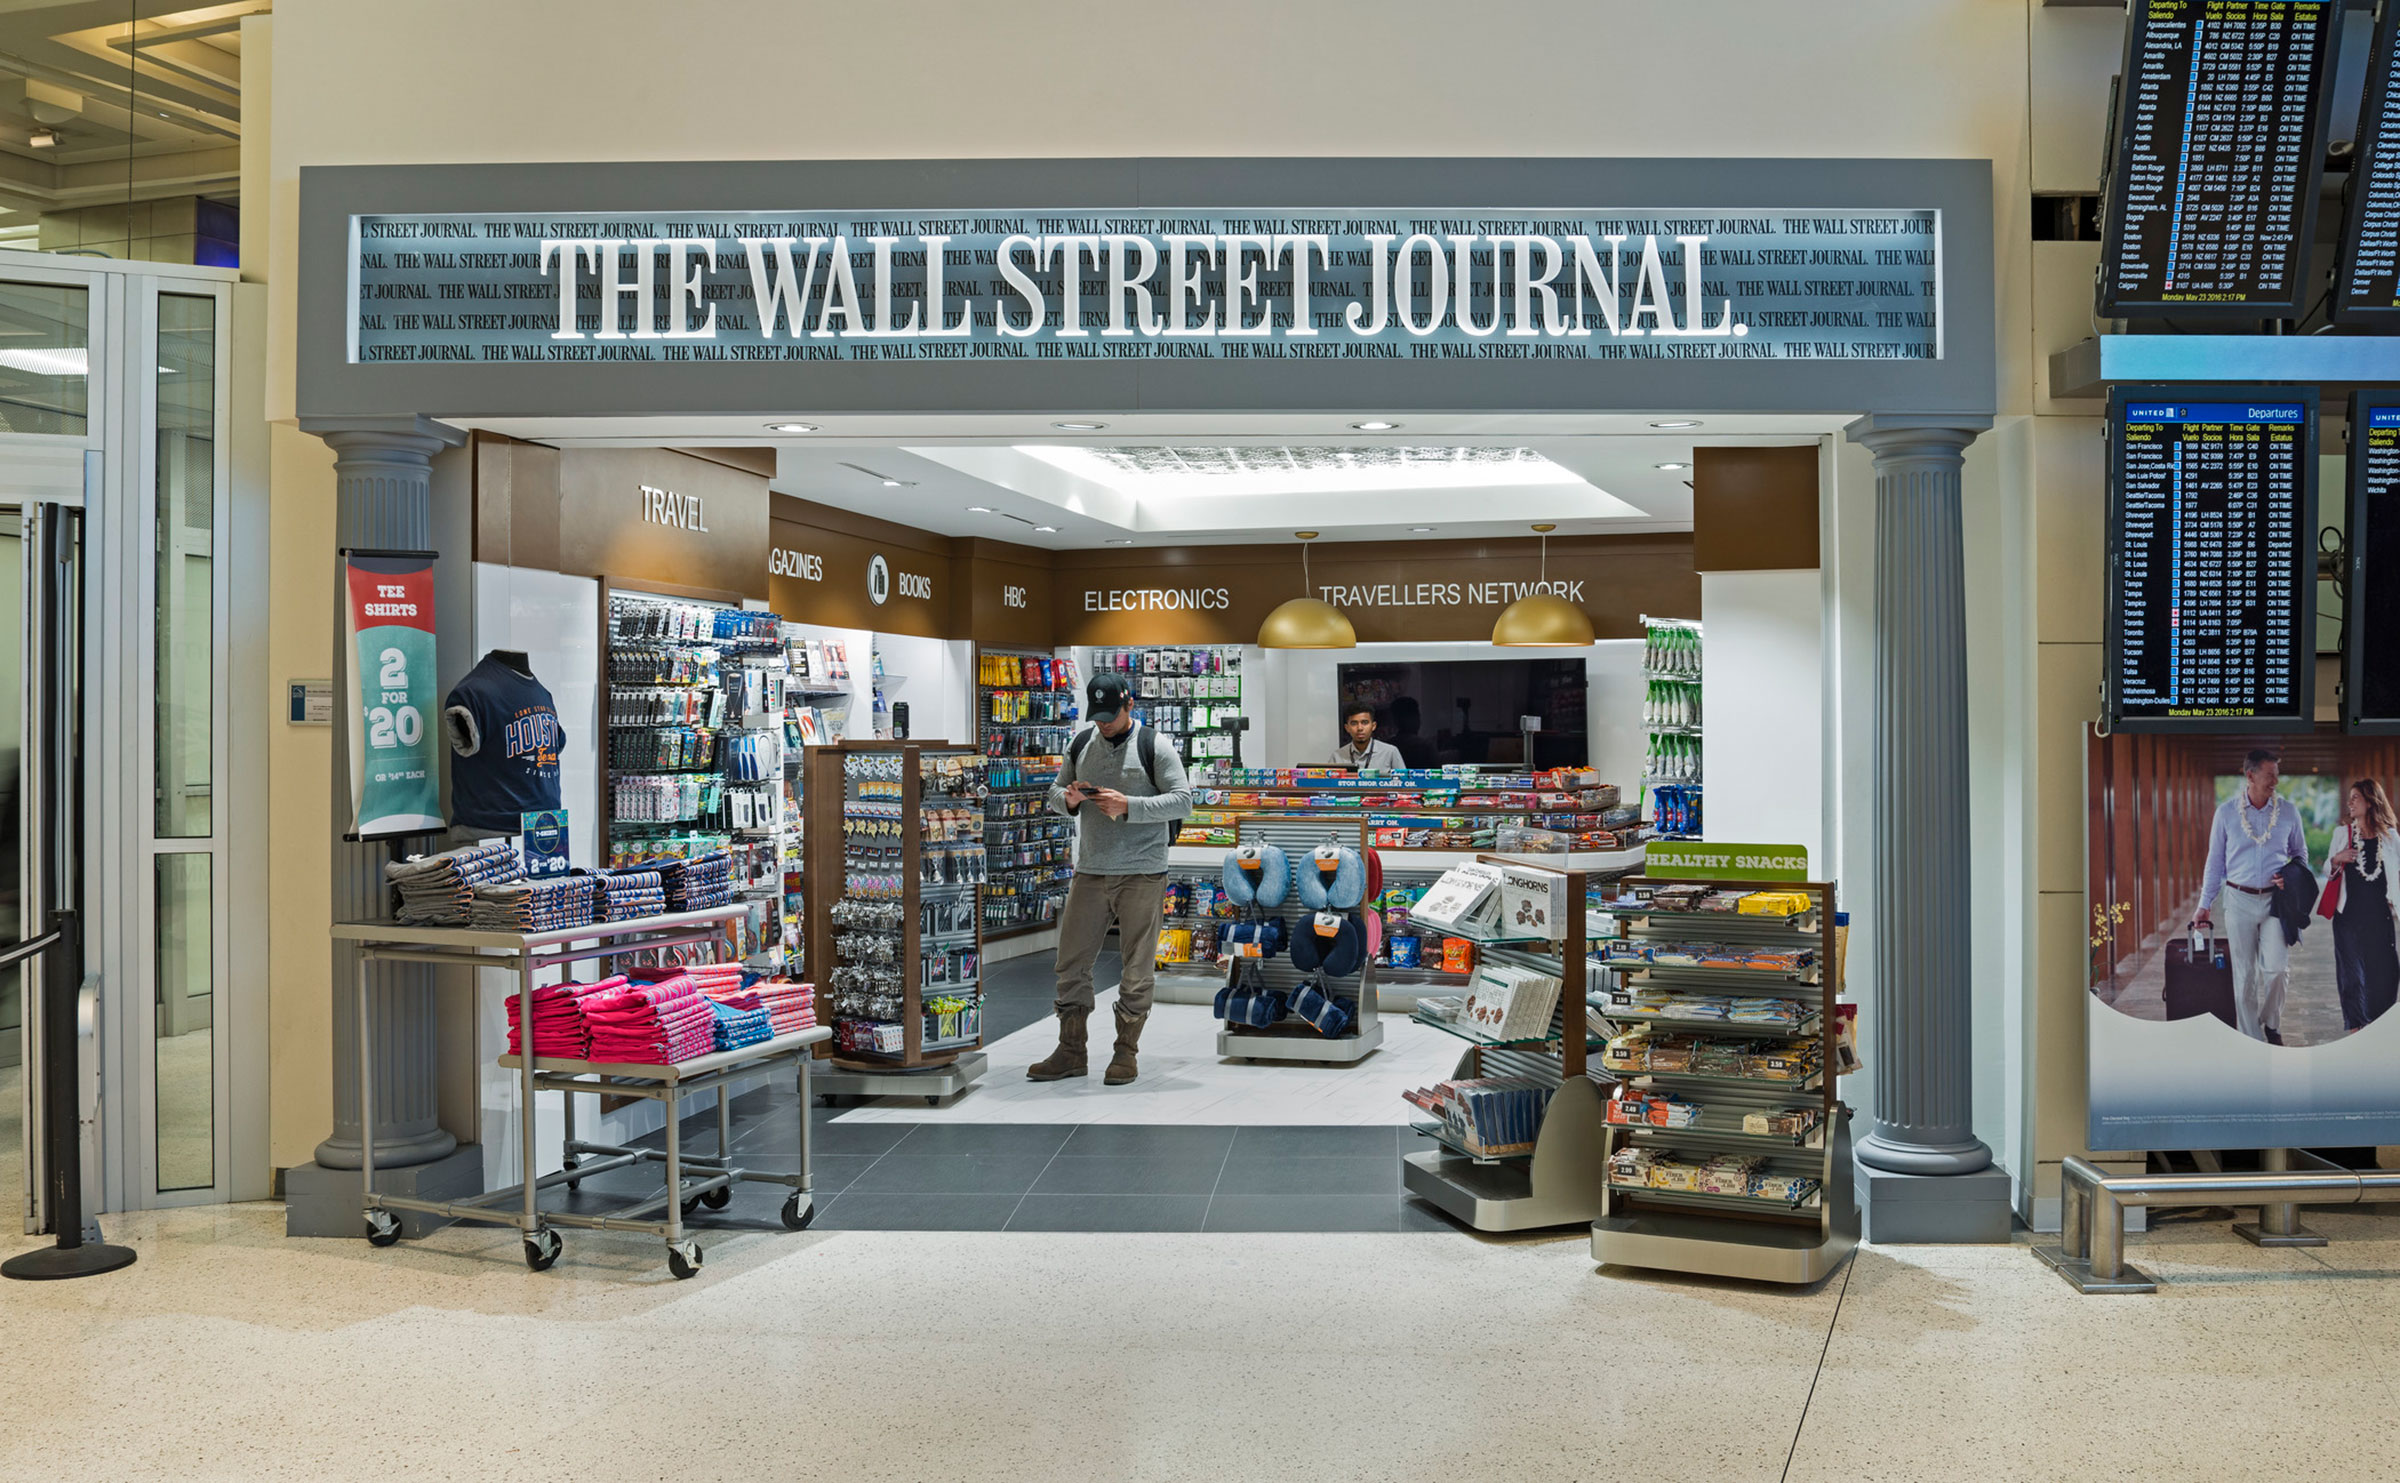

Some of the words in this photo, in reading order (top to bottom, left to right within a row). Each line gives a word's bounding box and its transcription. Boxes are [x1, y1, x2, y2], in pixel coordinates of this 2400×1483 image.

[2179, 1, 2187, 9] To
[2207, 1, 2224, 10] Flight
[2226, 2, 2248, 10] Partner
[2254, 2, 2269, 10] Time
[2271, 2, 2286, 10] Gate
[2294, 2, 2320, 11] Remarks
[2206, 12, 2223, 20] Vuelo
[2225, 12, 2246, 20] Socios
[2294, 13, 2318, 21] Estatus
[2146, 21, 2187, 30] Aguascalientes
[2145, 32, 2180, 40] Albuquerque
[2140, 73, 2171, 81] Amsterdam
[2139, 83, 2159, 91] Atlanta
[2132, 153, 2157, 161] Baltimore
[371, 223, 419, 238] STREET
[420, 223, 478, 238] JOURNAL.
[484, 223, 510, 238] THE
[513, 223, 547, 238] WALL
[550, 223, 599, 238] STREET
[601, 223, 659, 238] JOURNAL.
[666, 223, 693, 238] THE
[697, 223, 731, 238] WALL
[734, 222, 783, 238] STREET
[785, 222, 842, 238] JOURNAL.
[850, 222, 878, 238] THE
[881, 221, 915, 237] WALL
[919, 221, 969, 237] STREET
[971, 219, 1029, 235] JOURNAL.
[1037, 219, 1065, 235] THE
[1068, 219, 1101, 235] WALL
[1105, 219, 1154, 235] STREET
[1156, 219, 1216, 236] JOURNAL.
[1223, 219, 1250, 236] THE
[1254, 219, 1288, 236] WALL
[1291, 219, 1341, 236] STREET
[1343, 219, 1403, 236] JOURNAL.
[1409, 219, 1437, 236] THE
[1440, 220, 1475, 237] WALL
[1478, 220, 1528, 237] STREET
[1529, 220, 1589, 237] JOURNAL.
[1595, 220, 1623, 237] THE
[1626, 220, 1661, 237] WALL
[1664, 219, 1715, 235] STREET
[1716, 219, 1776, 235] JOURNAL.
[1783, 219, 1810, 235] THE
[1813, 219, 1847, 235] WALL
[1850, 219, 1899, 235] STREET
[2123, 233, 2142, 241] Boston
[2120, 262, 2149, 270] Brownsville
[540, 237, 717, 339] THE
[738, 234, 972, 338] WALL
[996, 232, 1329, 337] STREET
[1345, 232, 1749, 338] JOURNAL.
[2118, 281, 2138, 290] Calgary
[2162, 293, 2184, 302] Monday
[2185, 294, 2197, 302] May
[369, 344, 416, 361] STREET
[418, 344, 475, 361] JOURNAL.
[482, 344, 508, 361] THE
[511, 344, 545, 361] WALL
[548, 344, 597, 361] STREET
[598, 344, 656, 361] JOURNAL.
[663, 344, 689, 360] THE
[693, 344, 727, 360] WALL
[730, 344, 782, 360] STREET
[783, 344, 844, 360] JOURNAL.
[2132, 409, 2165, 417] UNITED
[2248, 407, 2299, 420] Departures
[2126, 424, 2155, 433] Departing
[2183, 424, 2199, 433] Flight
[2202, 424, 2223, 432] Partner
[2229, 424, 2244, 432] Time
[2246, 424, 2260, 432] Gate
[2268, 424, 2294, 432] Remarks
[2270, 434, 2293, 442] Estatus
[639, 484, 709, 534] TRAVEL
[2125, 511, 2154, 520] Shreveport
[2268, 541, 2292, 549] Departed
[899, 571, 932, 600] BOOKS
[2124, 580, 2143, 589] Tampa
[377, 584, 405, 599] TEE
[1318, 583, 1461, 607] TRAVELLERS
[1004, 585, 1027, 609] HBC
[1084, 588, 1230, 612] ELECTRONICS
[365, 603, 418, 618] SHIRTS
[379, 647, 409, 690] 2
[2123, 687, 2156, 695] Villahermosa
[381, 691, 408, 704] FOR
[2168, 708, 2191, 717] Monday
[2192, 708, 2205, 717] May
[2206, 708, 2214, 716] 23
[2214, 708, 2229, 716] 2016
[2230, 708, 2242, 716] 2:17
[2243, 708, 2254, 716] PM
[375, 774, 387, 782] OR
[406, 770, 425, 779] EACH
[530, 858, 540, 874] 2
[1646, 853, 1731, 868] HEALTHY
[1736, 855, 1808, 870] SNACKS
[1503, 872, 1549, 894] LONGHORNS
[1770, 1060, 1783, 1068] 3.59
